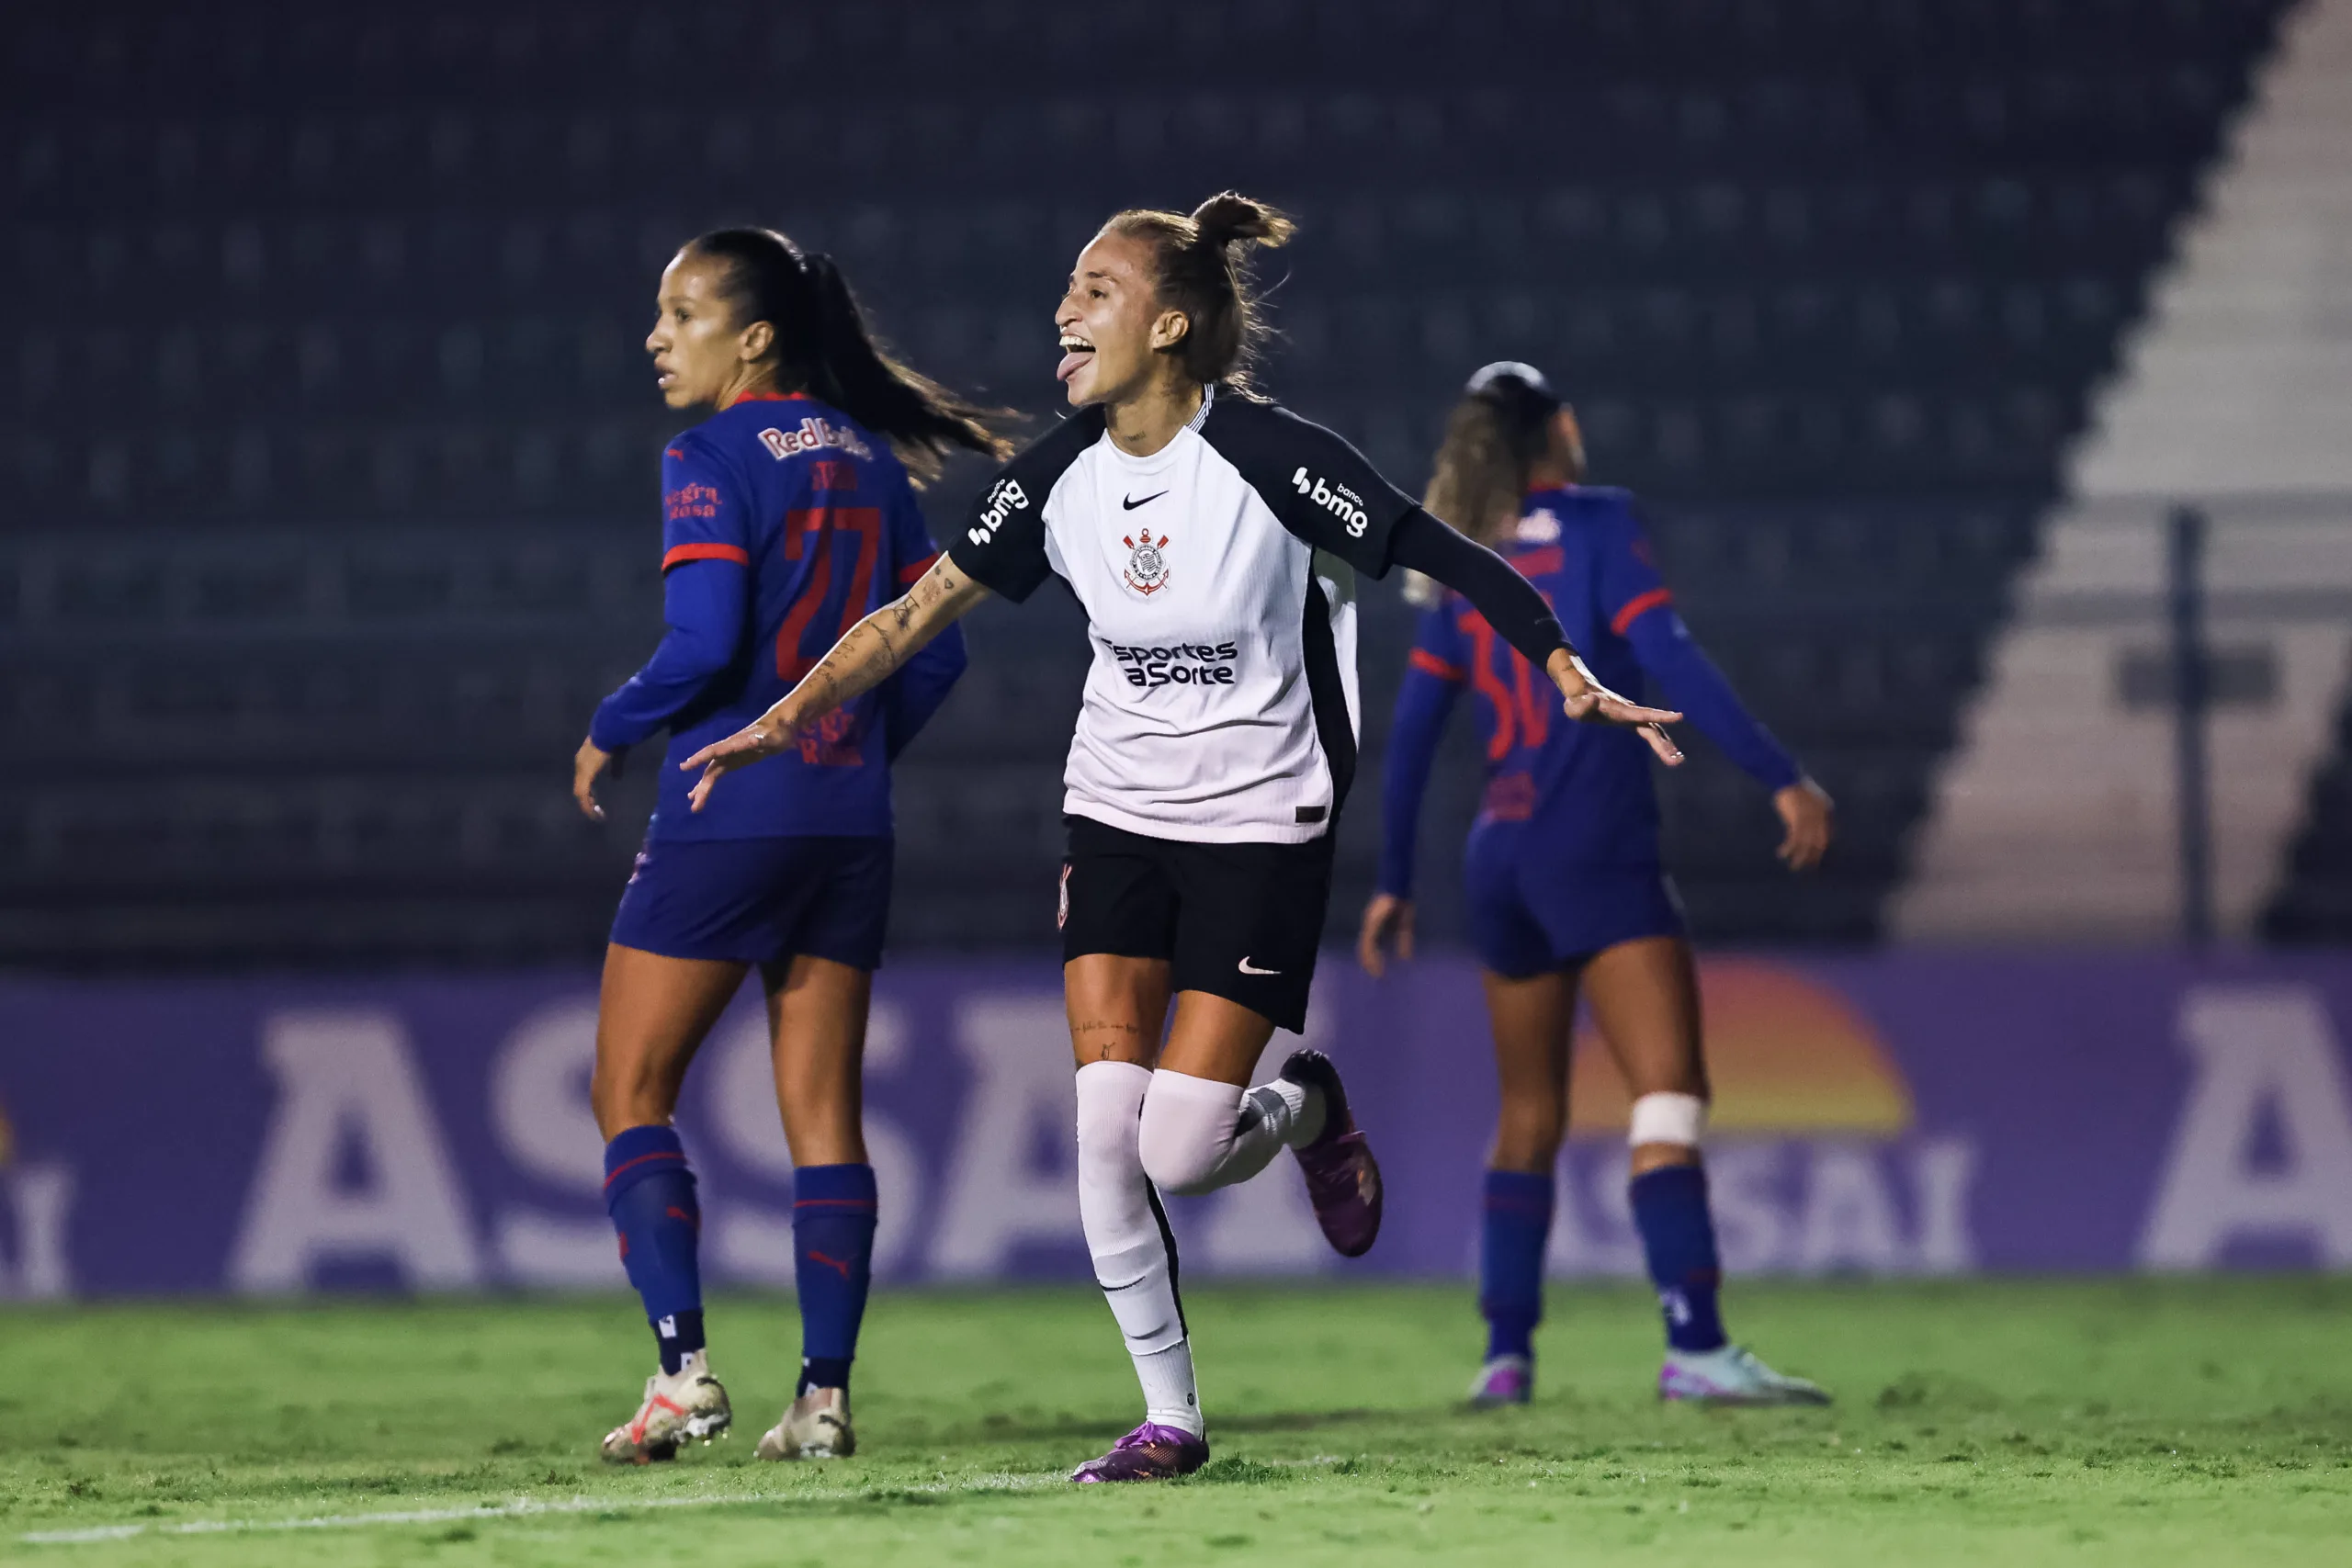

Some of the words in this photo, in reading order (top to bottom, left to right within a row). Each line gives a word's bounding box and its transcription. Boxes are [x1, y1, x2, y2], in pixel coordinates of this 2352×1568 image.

[979, 479, 1030, 533] bmg
[1310, 477, 1368, 537] bmg
[1337, 482, 1363, 506] banco
[775, 506, 881, 682] 27
[1101, 637, 1238, 666] sportes
